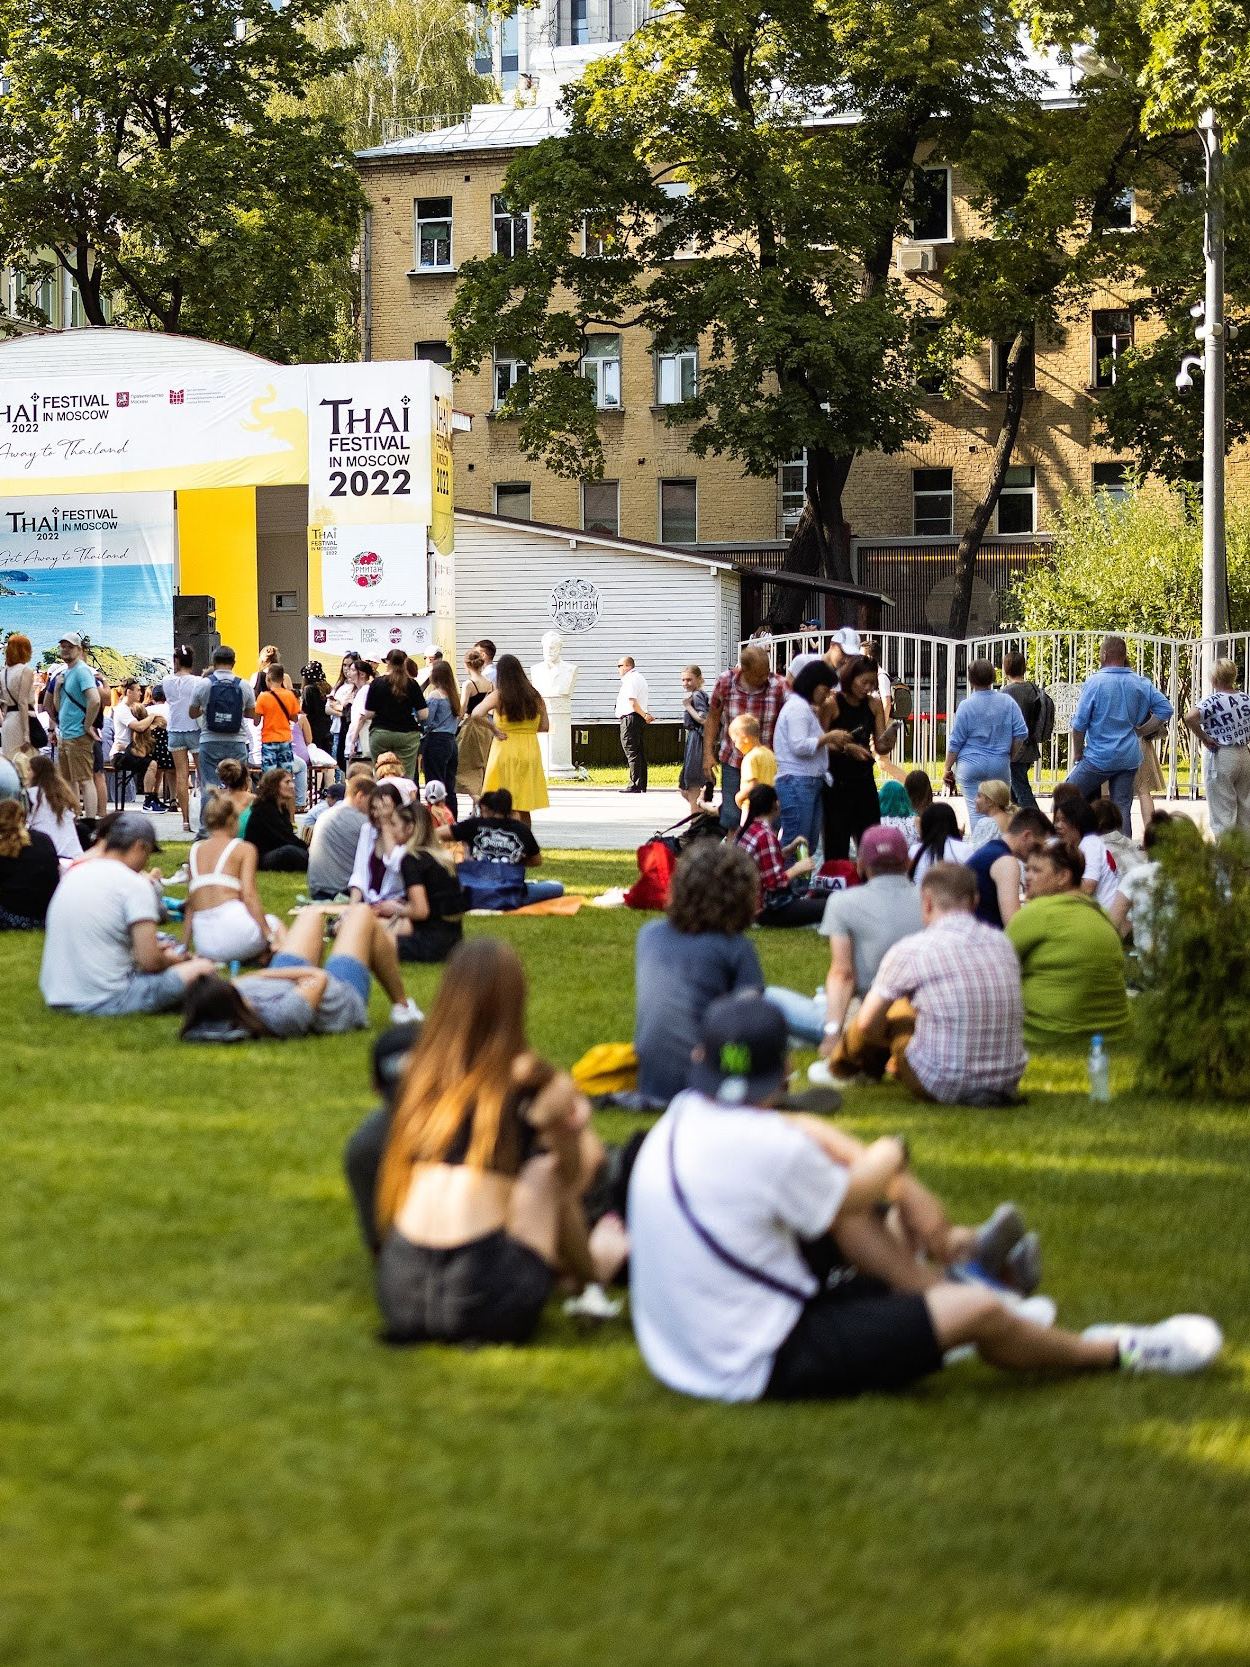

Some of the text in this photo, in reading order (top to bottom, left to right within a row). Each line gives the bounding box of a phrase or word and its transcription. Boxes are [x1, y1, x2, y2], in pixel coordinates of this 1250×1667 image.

[43, 394, 109, 408] FESTIVAL
[43, 410, 109, 421] IN MOSCOW
[12, 424, 38, 433] 2022
[41, 444, 56, 457] to
[57, 439, 129, 460] Thailand
[329, 435, 410, 452] FESTIVAL
[330, 454, 410, 467] IN MOSCOW
[329, 469, 410, 497] 2022
[62, 509, 118, 520] FESTIVAL
[62, 522, 118, 531] IN MOSCOW
[23, 550, 60, 570] Away
[62, 551, 74, 561] to
[74, 547, 129, 563] Thailand
[815, 878, 842, 890] FILA
